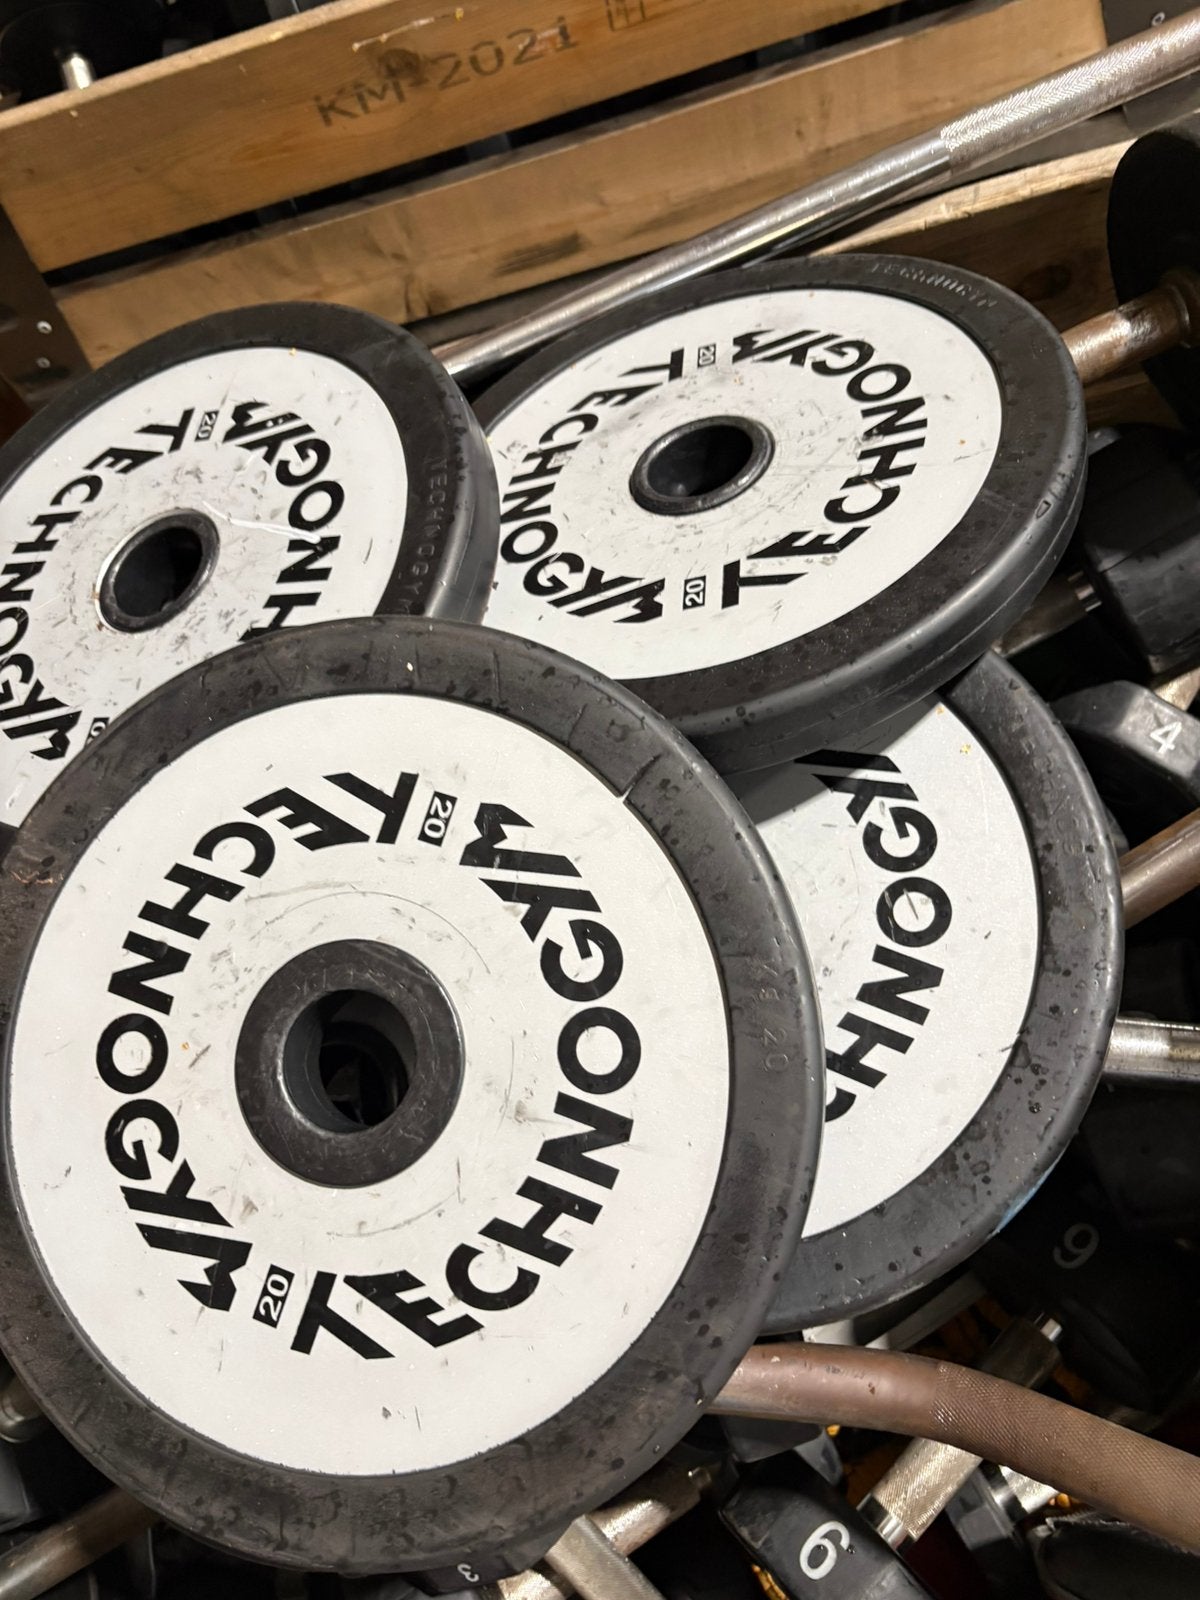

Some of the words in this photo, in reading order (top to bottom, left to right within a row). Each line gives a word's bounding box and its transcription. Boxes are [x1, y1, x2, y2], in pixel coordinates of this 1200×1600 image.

[697, 344, 716, 367] 20
[195, 410, 219, 442] 20
[500, 348, 685, 623] TECHNOGYM
[721, 329, 927, 609] TECHNOGYM
[683, 577, 706, 610] 20
[1149, 721, 1182, 754] 4
[418, 791, 457, 845] 20
[96, 772, 419, 1311] TECHNOGYM
[290, 802, 641, 1360] TECHNOGYM
[253, 1264, 295, 1328] 20
[457, 1563, 479, 1582] 3
